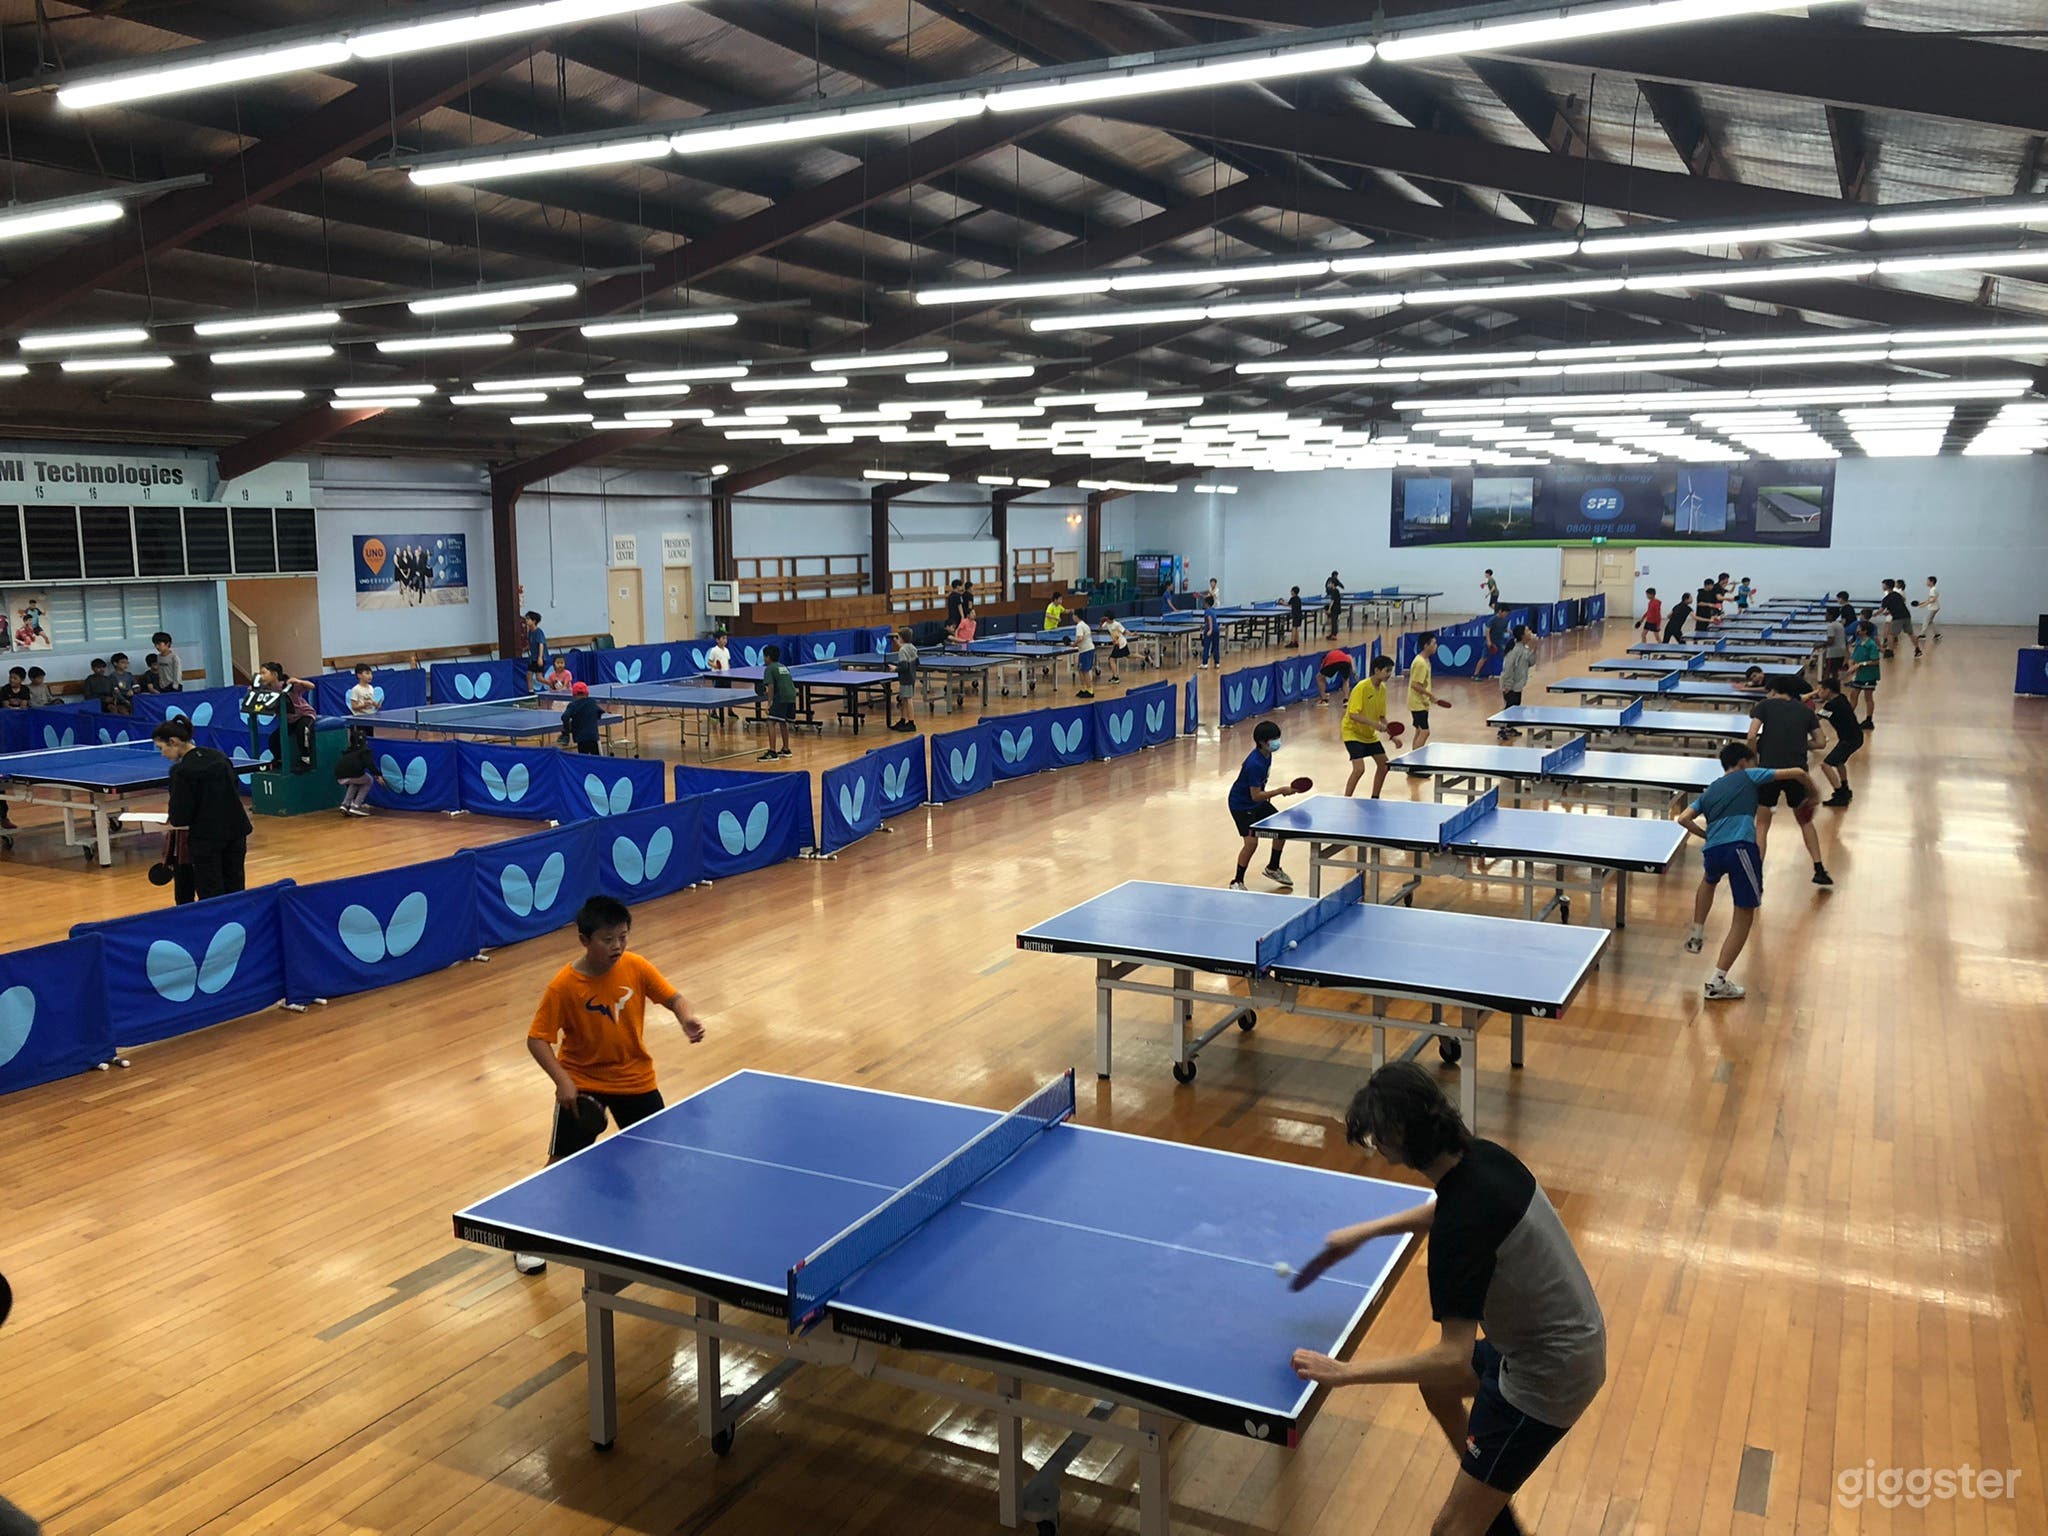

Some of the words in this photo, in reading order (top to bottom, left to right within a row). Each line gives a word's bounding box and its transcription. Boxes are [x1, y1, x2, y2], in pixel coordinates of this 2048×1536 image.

[34, 461, 183, 487] Technologies
[35, 486, 44, 498] 15
[89, 487, 98, 499] 16
[143, 488, 151, 500] 17
[191, 488, 199, 500] 18
[242, 489, 249, 501] 19
[285, 490, 293, 501] 20
[1586, 498, 1617, 509] SPE
[1566, 523, 1591, 533] 0800
[1593, 523, 1615, 533] SPE
[364, 549, 384, 558] UNO
[616, 551, 635, 560] CENTRE
[264, 692, 280, 706] 7
[263, 780, 273, 795] 11
[1023, 940, 1054, 952] BUTTERFLY
[464, 1226, 506, 1249] BUTTERFLY
[741, 1297, 775, 1314] Centrefold
